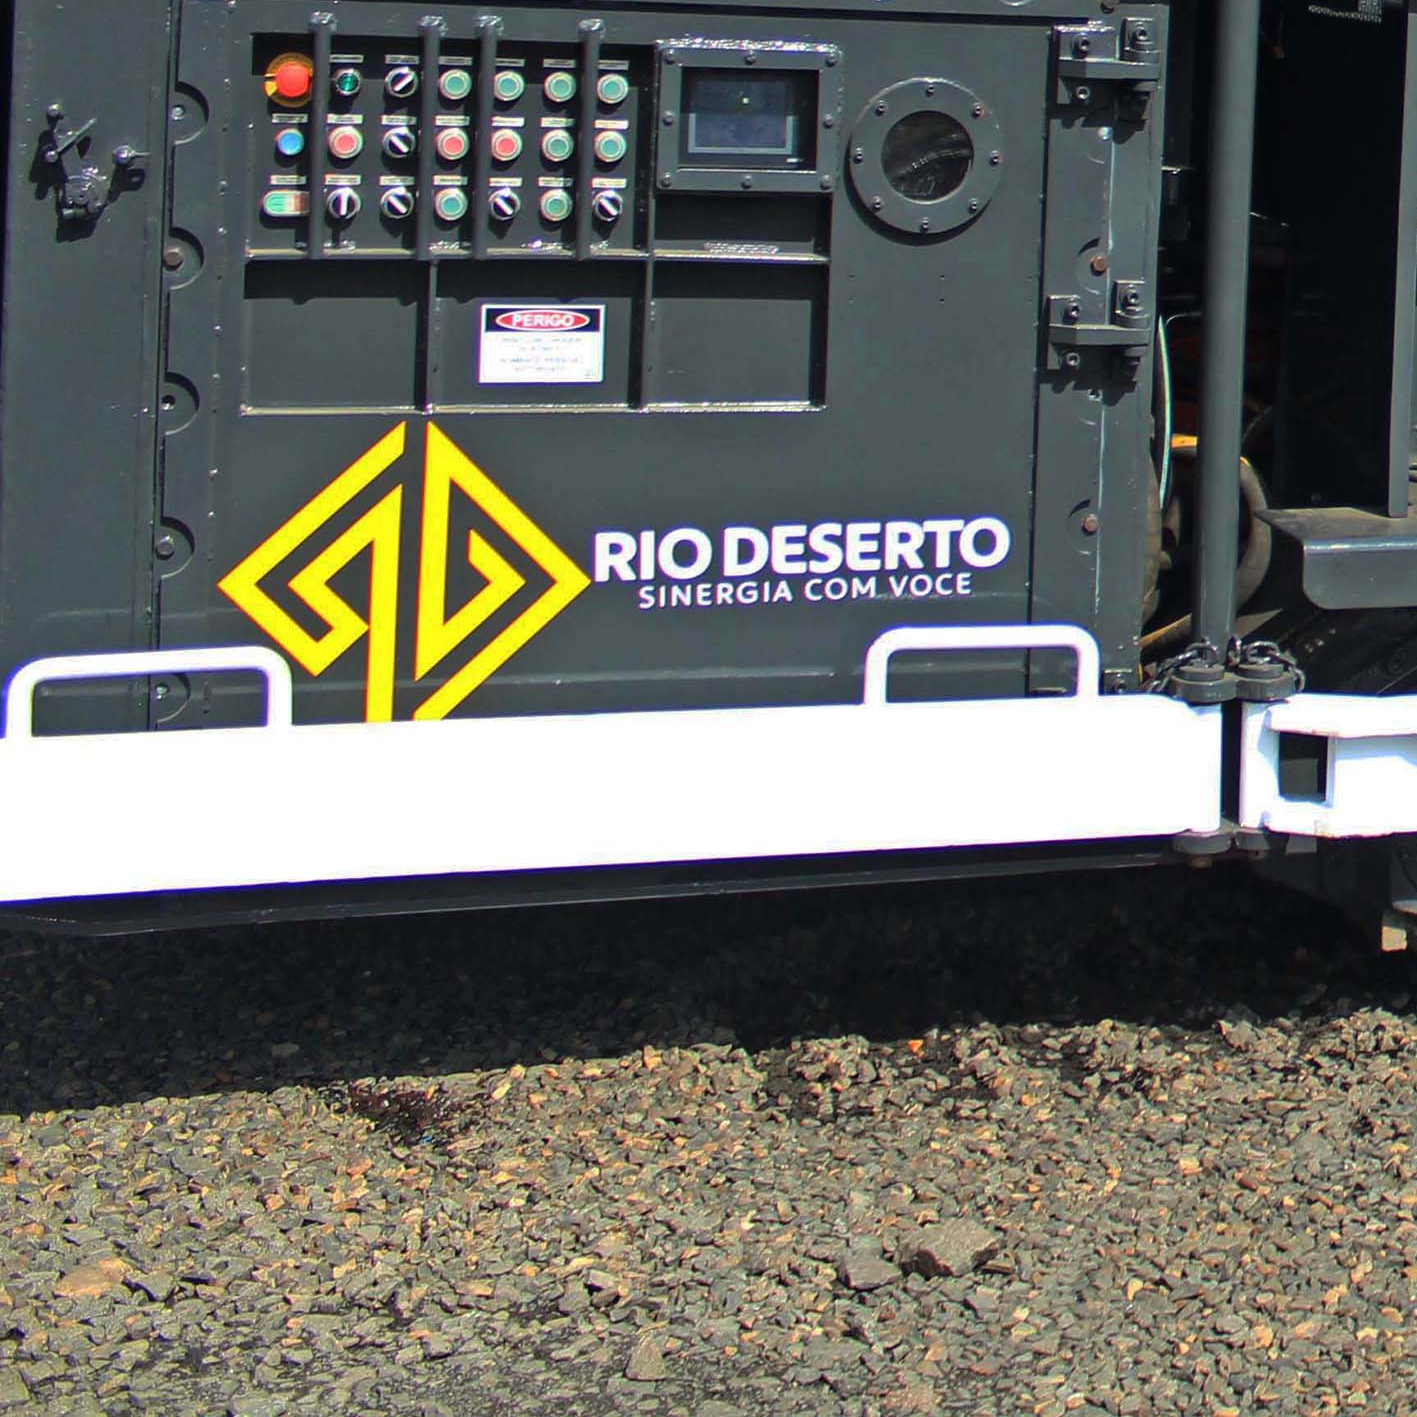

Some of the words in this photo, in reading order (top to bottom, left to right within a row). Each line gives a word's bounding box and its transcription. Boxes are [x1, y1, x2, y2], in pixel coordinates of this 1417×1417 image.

[511, 314, 575, 328] PERIGO
[593, 527, 713, 582] RIO
[722, 517, 1011, 577] DESERTO
[638, 580, 793, 610] SINERGIA
[804, 576, 877, 601] COM
[889, 573, 972, 598] VOCE
